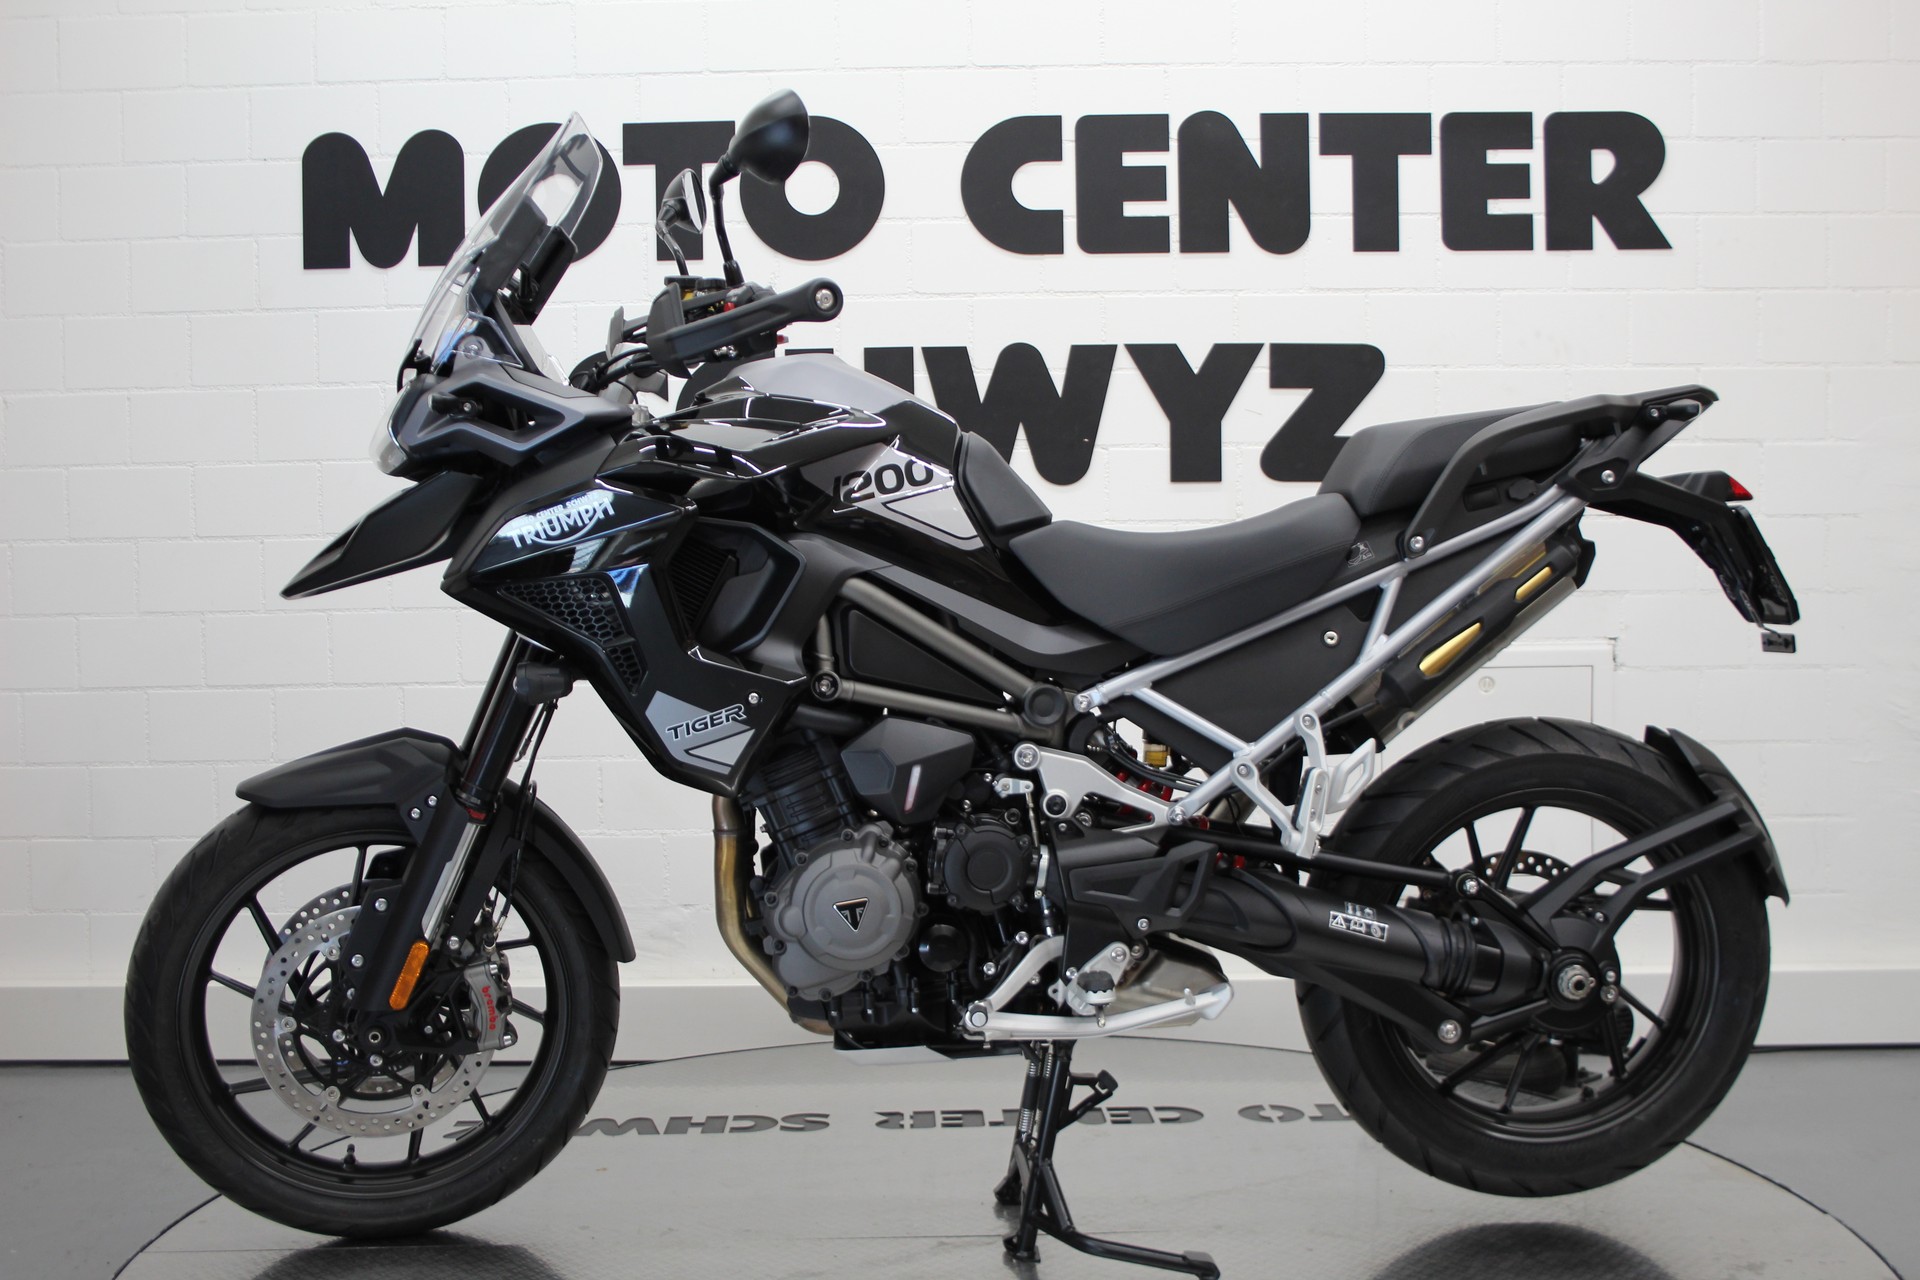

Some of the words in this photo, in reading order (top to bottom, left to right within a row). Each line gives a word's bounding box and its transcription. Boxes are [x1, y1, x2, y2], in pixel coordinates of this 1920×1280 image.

[302, 115, 885, 270] MOTO
[960, 110, 1673, 255] CENTER
[832, 458, 934, 505] 1200
[508, 497, 615, 548] TRIUMPH
[665, 703, 747, 741] TIGER
[481, 985, 499, 1032] brembo
[442, 1112, 831, 1140] SCHW
